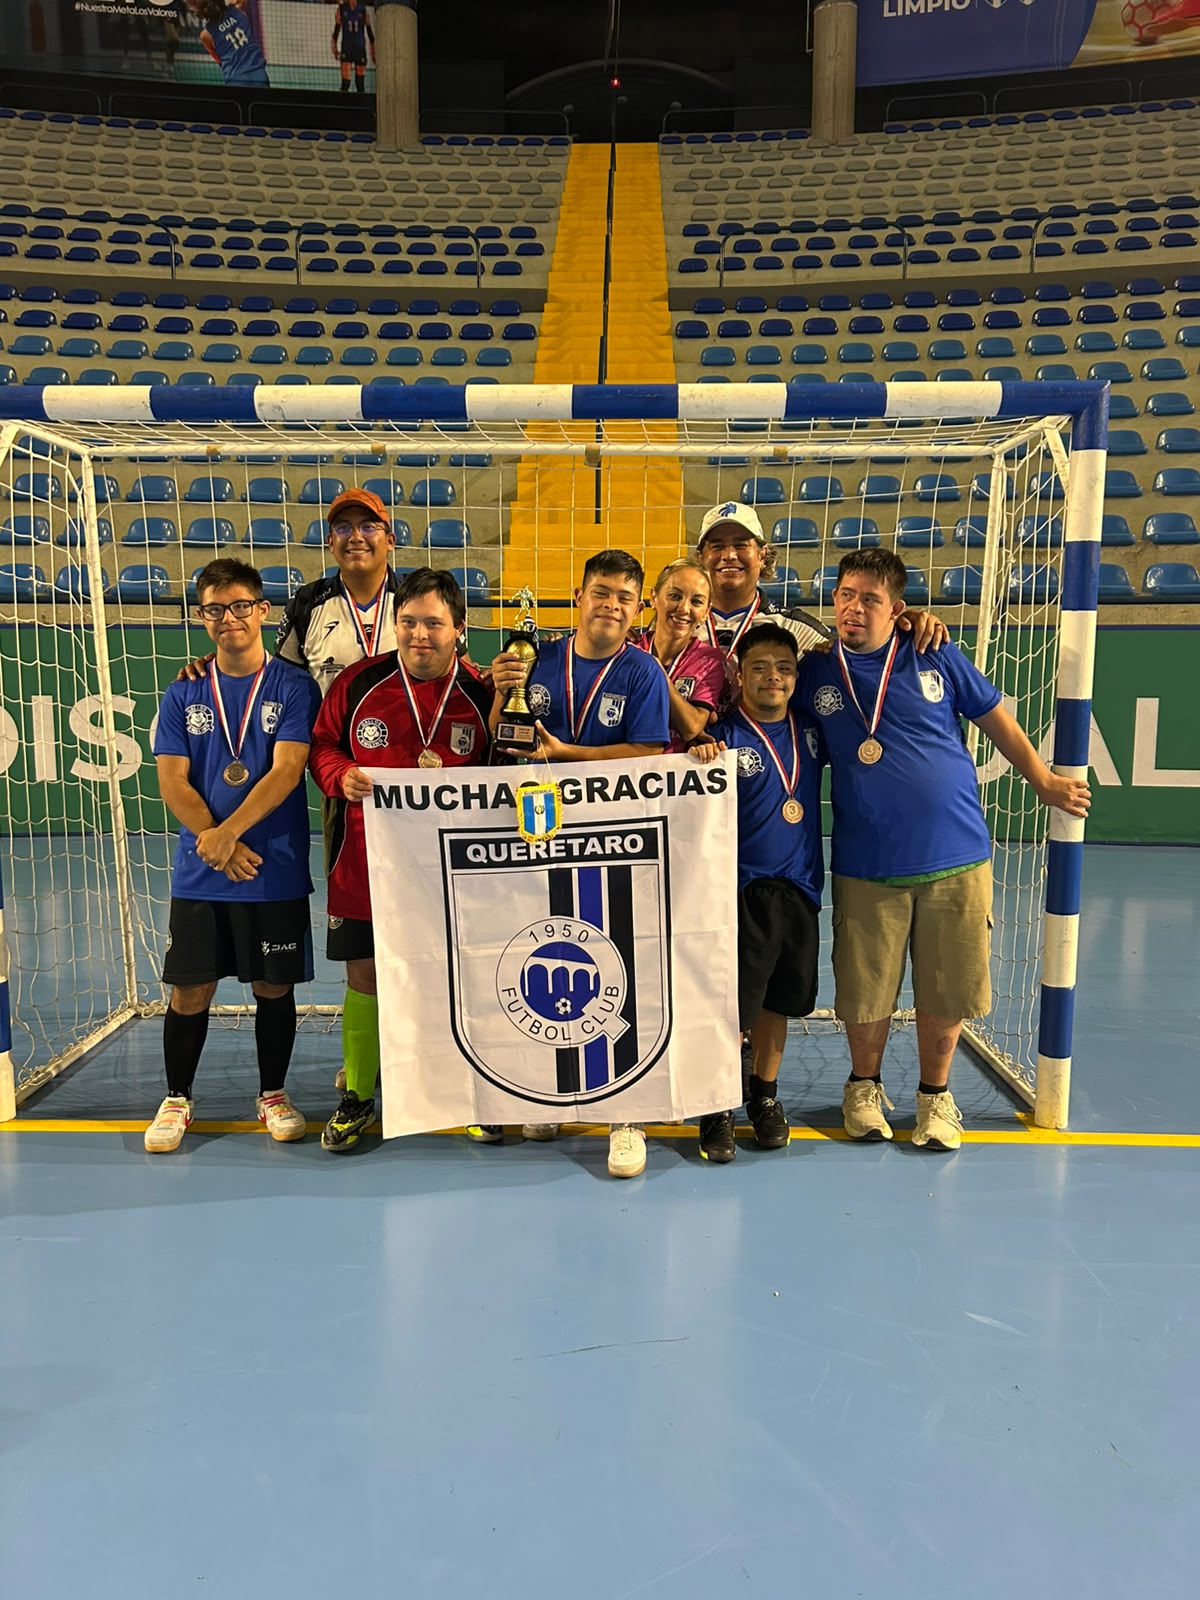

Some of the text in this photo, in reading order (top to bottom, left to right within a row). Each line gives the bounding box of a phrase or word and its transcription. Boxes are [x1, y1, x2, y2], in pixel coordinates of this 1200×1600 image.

[75, 2, 178, 18] #NuestraMetaLosValores
[218, 17, 238, 33] GUA
[373, 767, 728, 811] MUCHA GRACIAS
[788, 805, 797, 815] 3
[466, 833, 644, 864] QUERETARO
[528, 922, 590, 943] 1950
[502, 985, 619, 1041] FUTBOL CLUB
